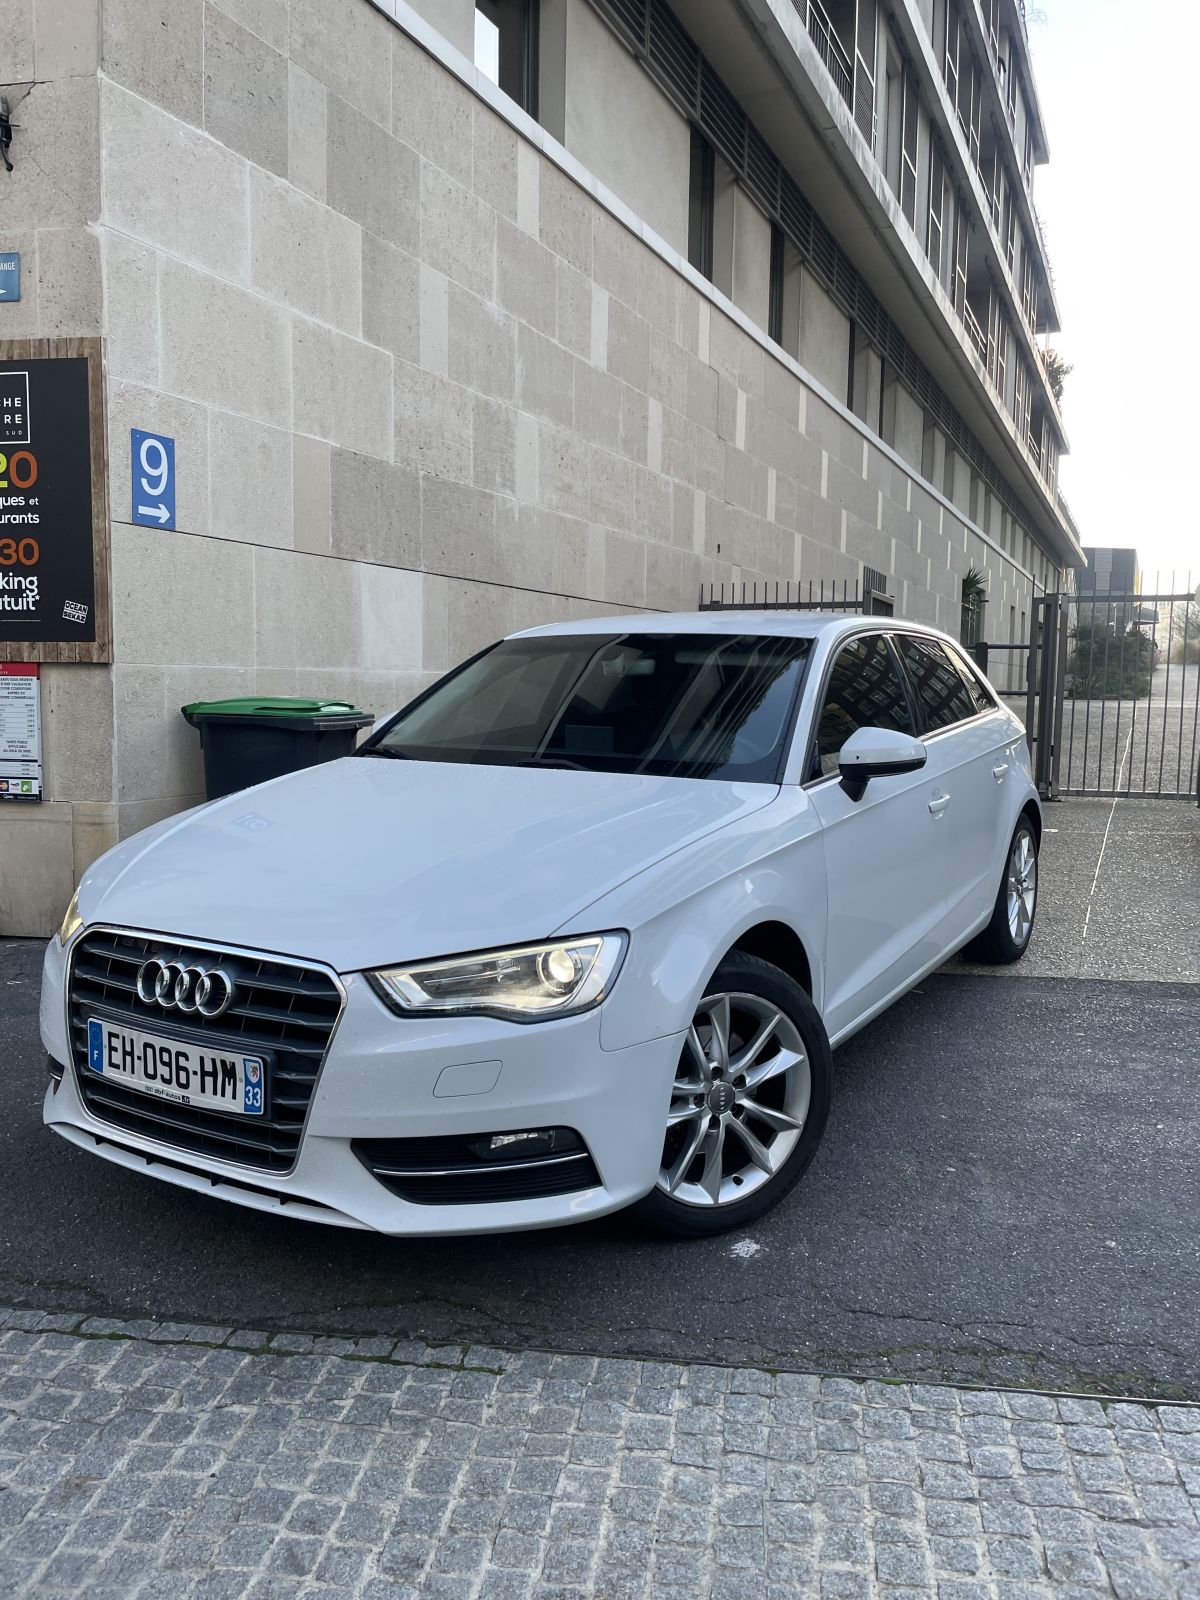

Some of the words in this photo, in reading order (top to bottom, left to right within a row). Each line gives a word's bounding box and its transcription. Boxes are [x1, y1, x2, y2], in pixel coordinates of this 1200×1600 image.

[0, 397, 22, 408] HE
[139, 437, 169, 497] 9
[29, 497, 39, 506] et
[65, 601, 88, 614] OCEAN
[93, 1050, 99, 1061] F
[107, 1031, 238, 1101] EH-096-HM
[245, 1085, 263, 1107] 33
